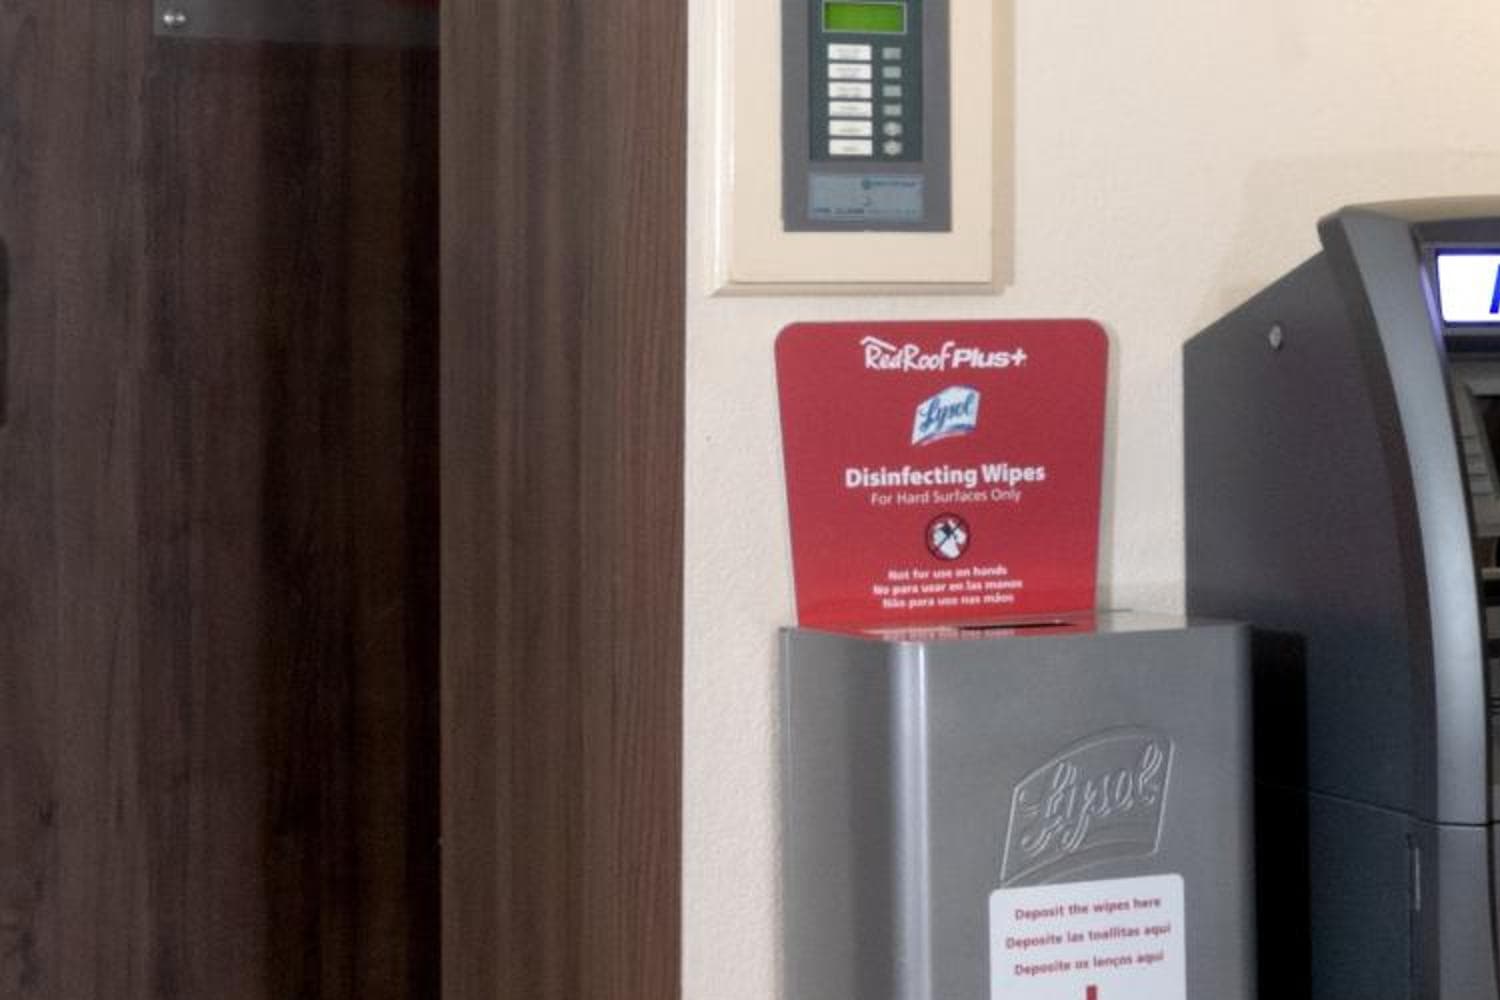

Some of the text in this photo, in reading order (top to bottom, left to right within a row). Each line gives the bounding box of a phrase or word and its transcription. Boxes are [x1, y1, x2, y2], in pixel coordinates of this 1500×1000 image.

[951, 347, 1028, 369] Plus+
[920, 392, 976, 433] Lysol
[844, 463, 1046, 488] Disinfecting Wipes
[871, 488, 1021, 505] For Hard Surfaces Only
[888, 566, 1008, 580] Not for use on hands
[873, 579, 1024, 596] No para usar en las manos
[908, 597, 934, 609] para
[937, 596, 958, 606] uso
[961, 595, 981, 605] nas
[1020, 743, 1163, 857] Lysol
[1015, 898, 1161, 920] Deposit the wipes here
[1005, 932, 1063, 950] Deposite
[1067, 931, 1085, 942] las
[1088, 925, 1140, 941] toallitas
[1014, 959, 1071, 976] Deposite
[1075, 960, 1089, 970] os
[1093, 955, 1133, 968] lenços
